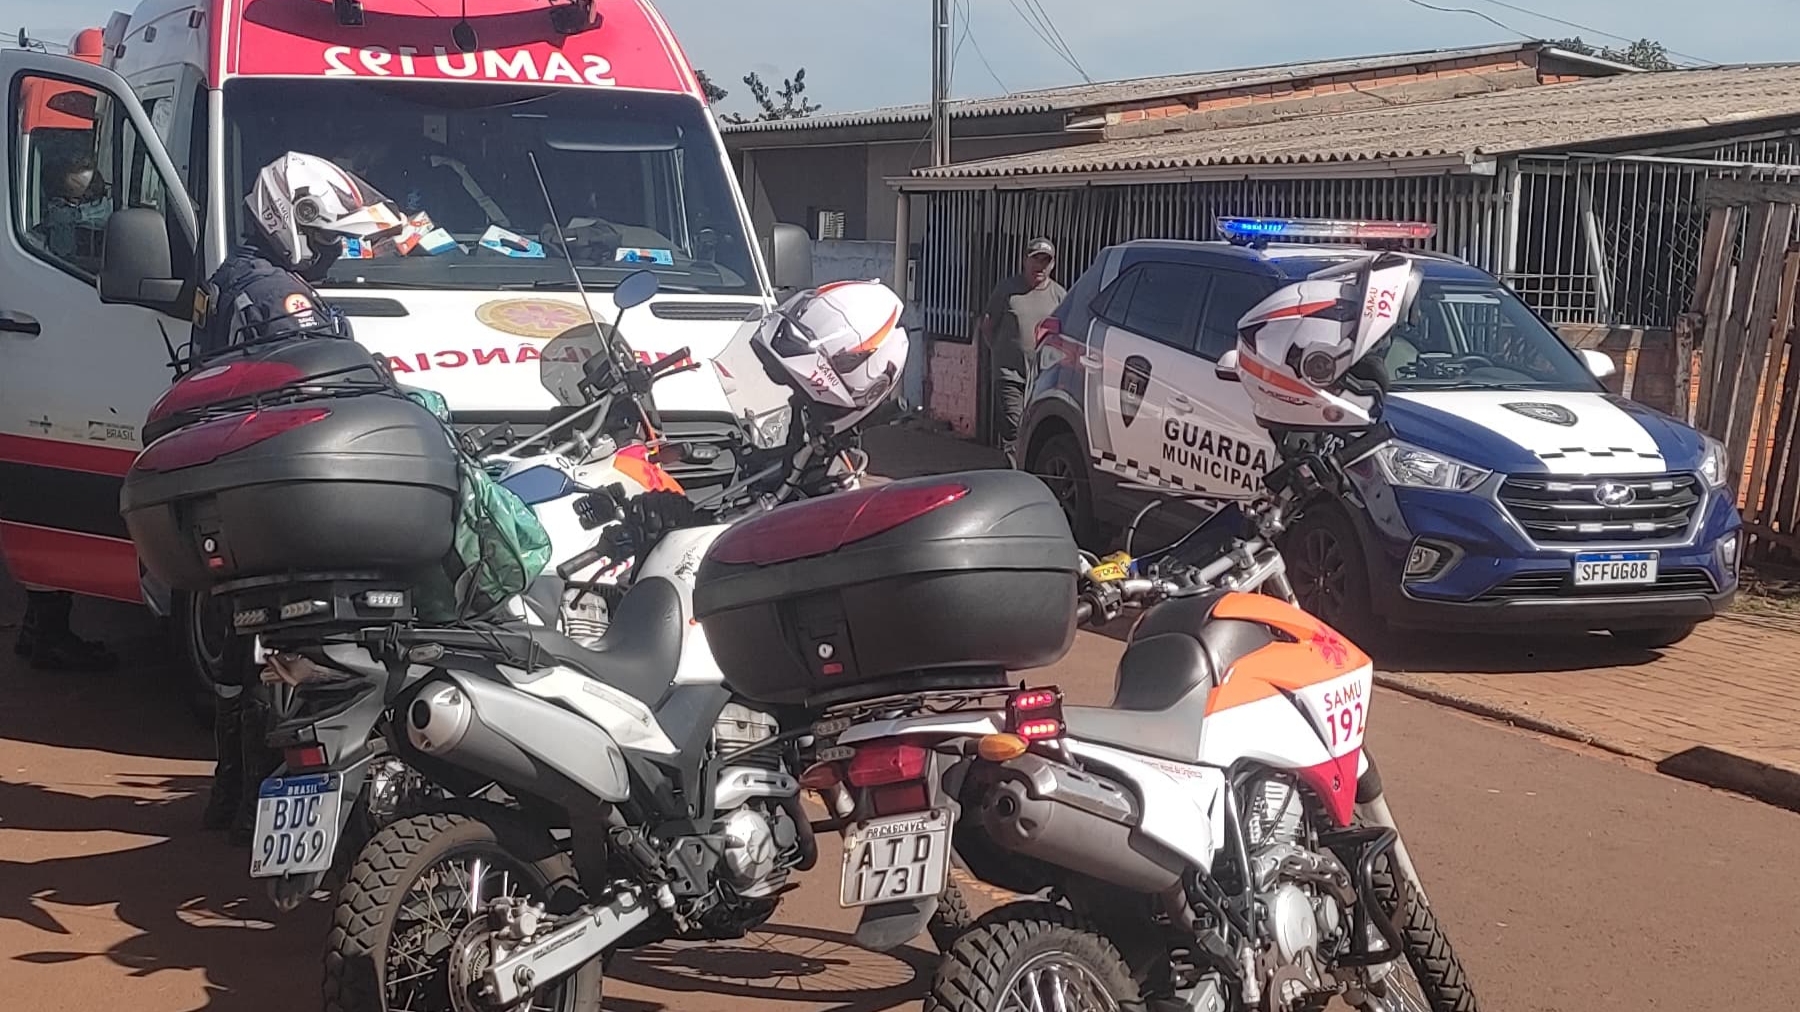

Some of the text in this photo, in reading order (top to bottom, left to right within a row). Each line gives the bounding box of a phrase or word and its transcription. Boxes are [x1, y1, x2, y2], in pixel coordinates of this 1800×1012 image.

[261, 206, 278, 230] 192
[1363, 287, 1378, 318] SAMU
[1376, 289, 1396, 319] 192
[810, 370, 829, 396] 192
[820, 363, 840, 387] SAMU
[106, 428, 135, 442] BRASIL
[1164, 417, 1267, 474] GUARDA
[1323, 679, 1362, 712] SAMU
[1326, 701, 1364, 747] 192
[287, 784, 318, 796] BRASIL
[273, 795, 322, 830] BDC
[262, 829, 326, 867] 9D69
[855, 862, 927, 901] 1731
